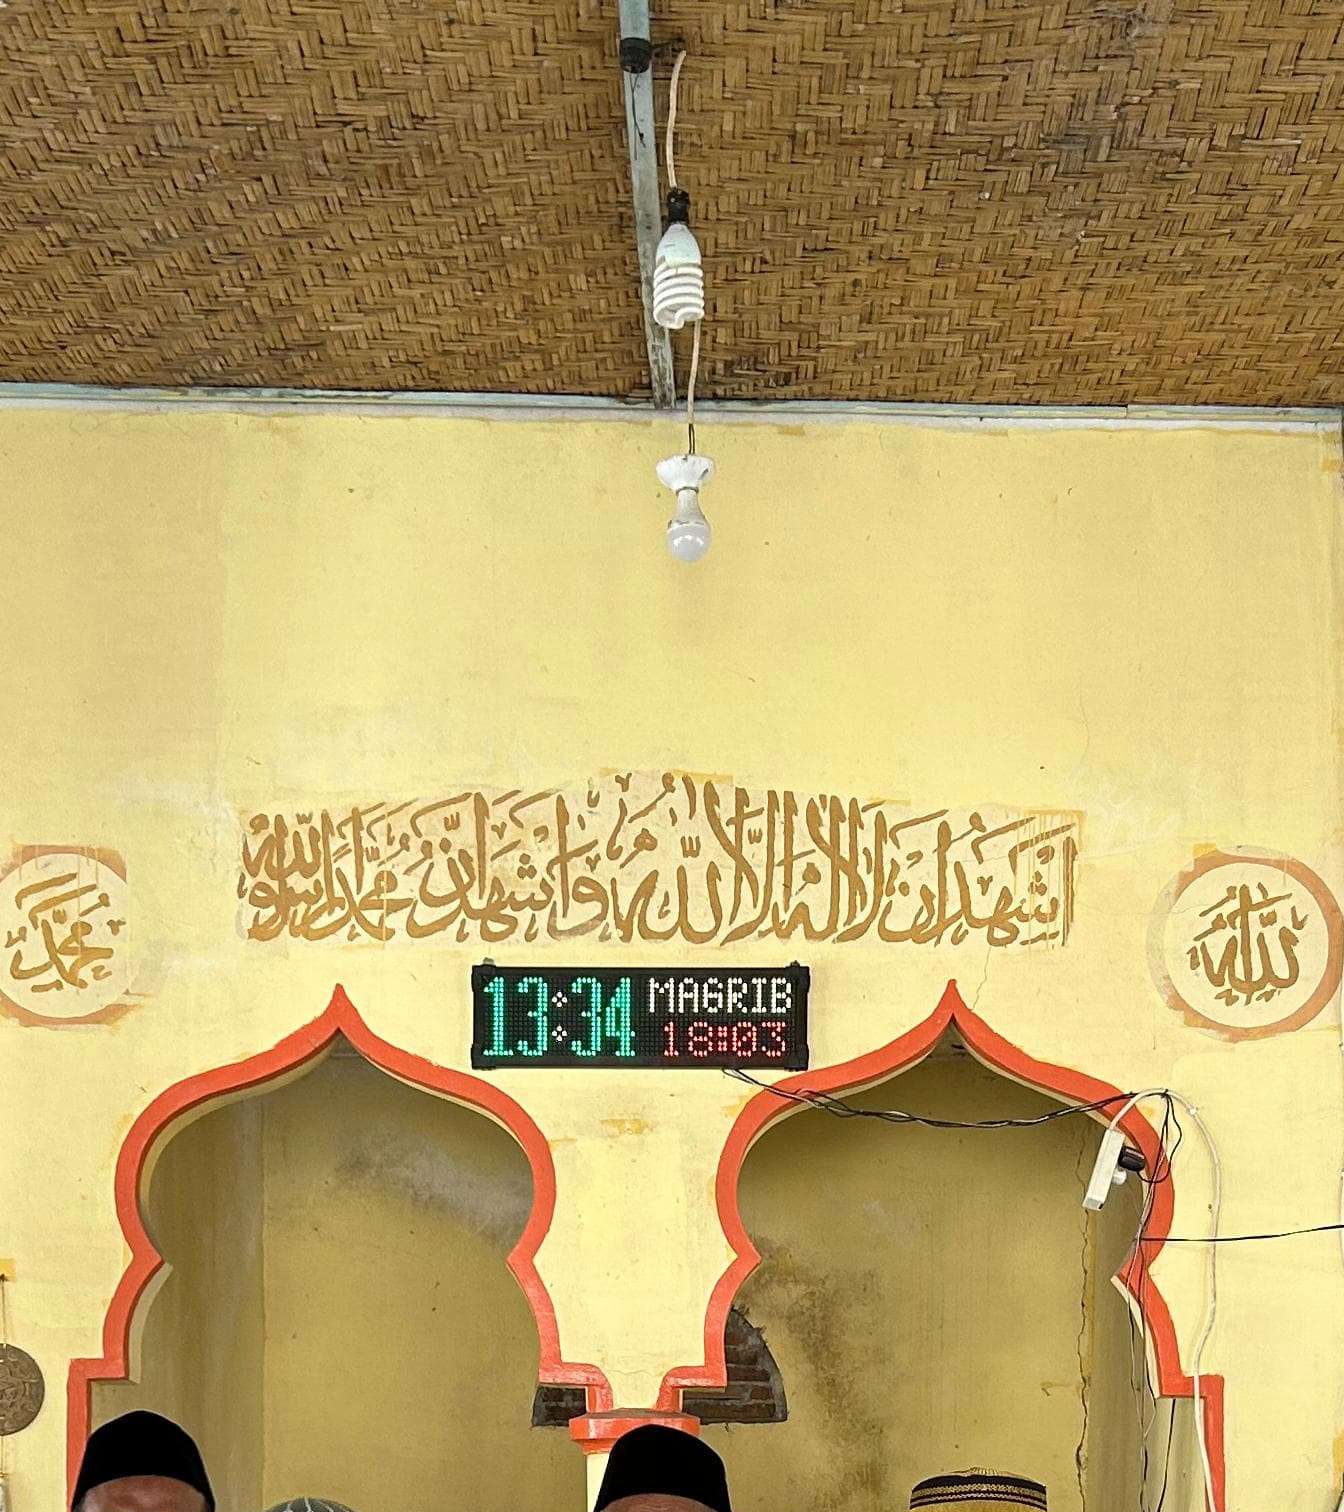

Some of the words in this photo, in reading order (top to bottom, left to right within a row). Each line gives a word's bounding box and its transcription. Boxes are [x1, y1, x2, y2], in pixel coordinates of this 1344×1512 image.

[649, 977, 792, 1013] MAGRIB
[483, 976, 636, 1057] 13:34
[664, 1021, 786, 1057] 18:03
